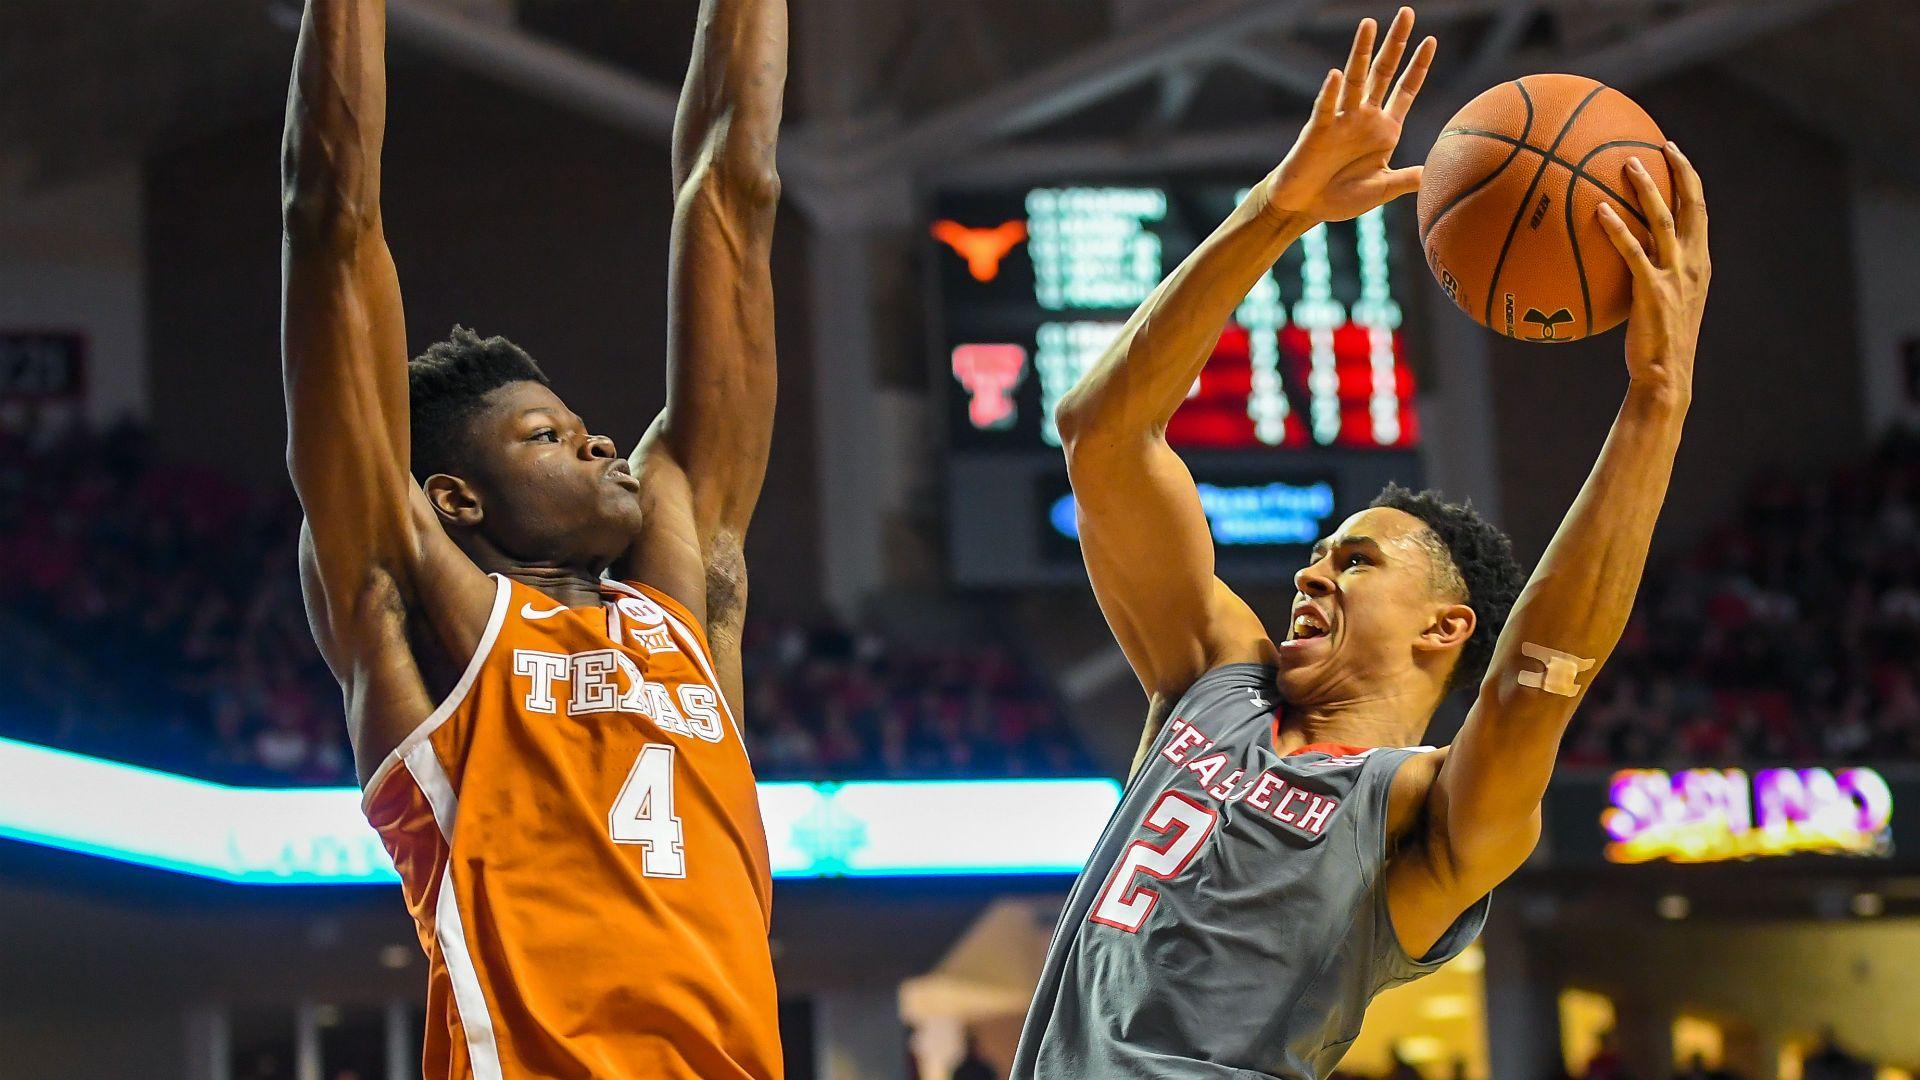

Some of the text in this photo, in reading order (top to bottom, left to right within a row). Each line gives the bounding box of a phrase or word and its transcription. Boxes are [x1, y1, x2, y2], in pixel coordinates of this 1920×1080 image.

[1505, 293, 1515, 324] UNDER
[513, 648, 724, 743] TEXAS
[608, 743, 687, 879] 4
[1232, 771, 1338, 836] ECH
[1089, 789, 1218, 934] 2
